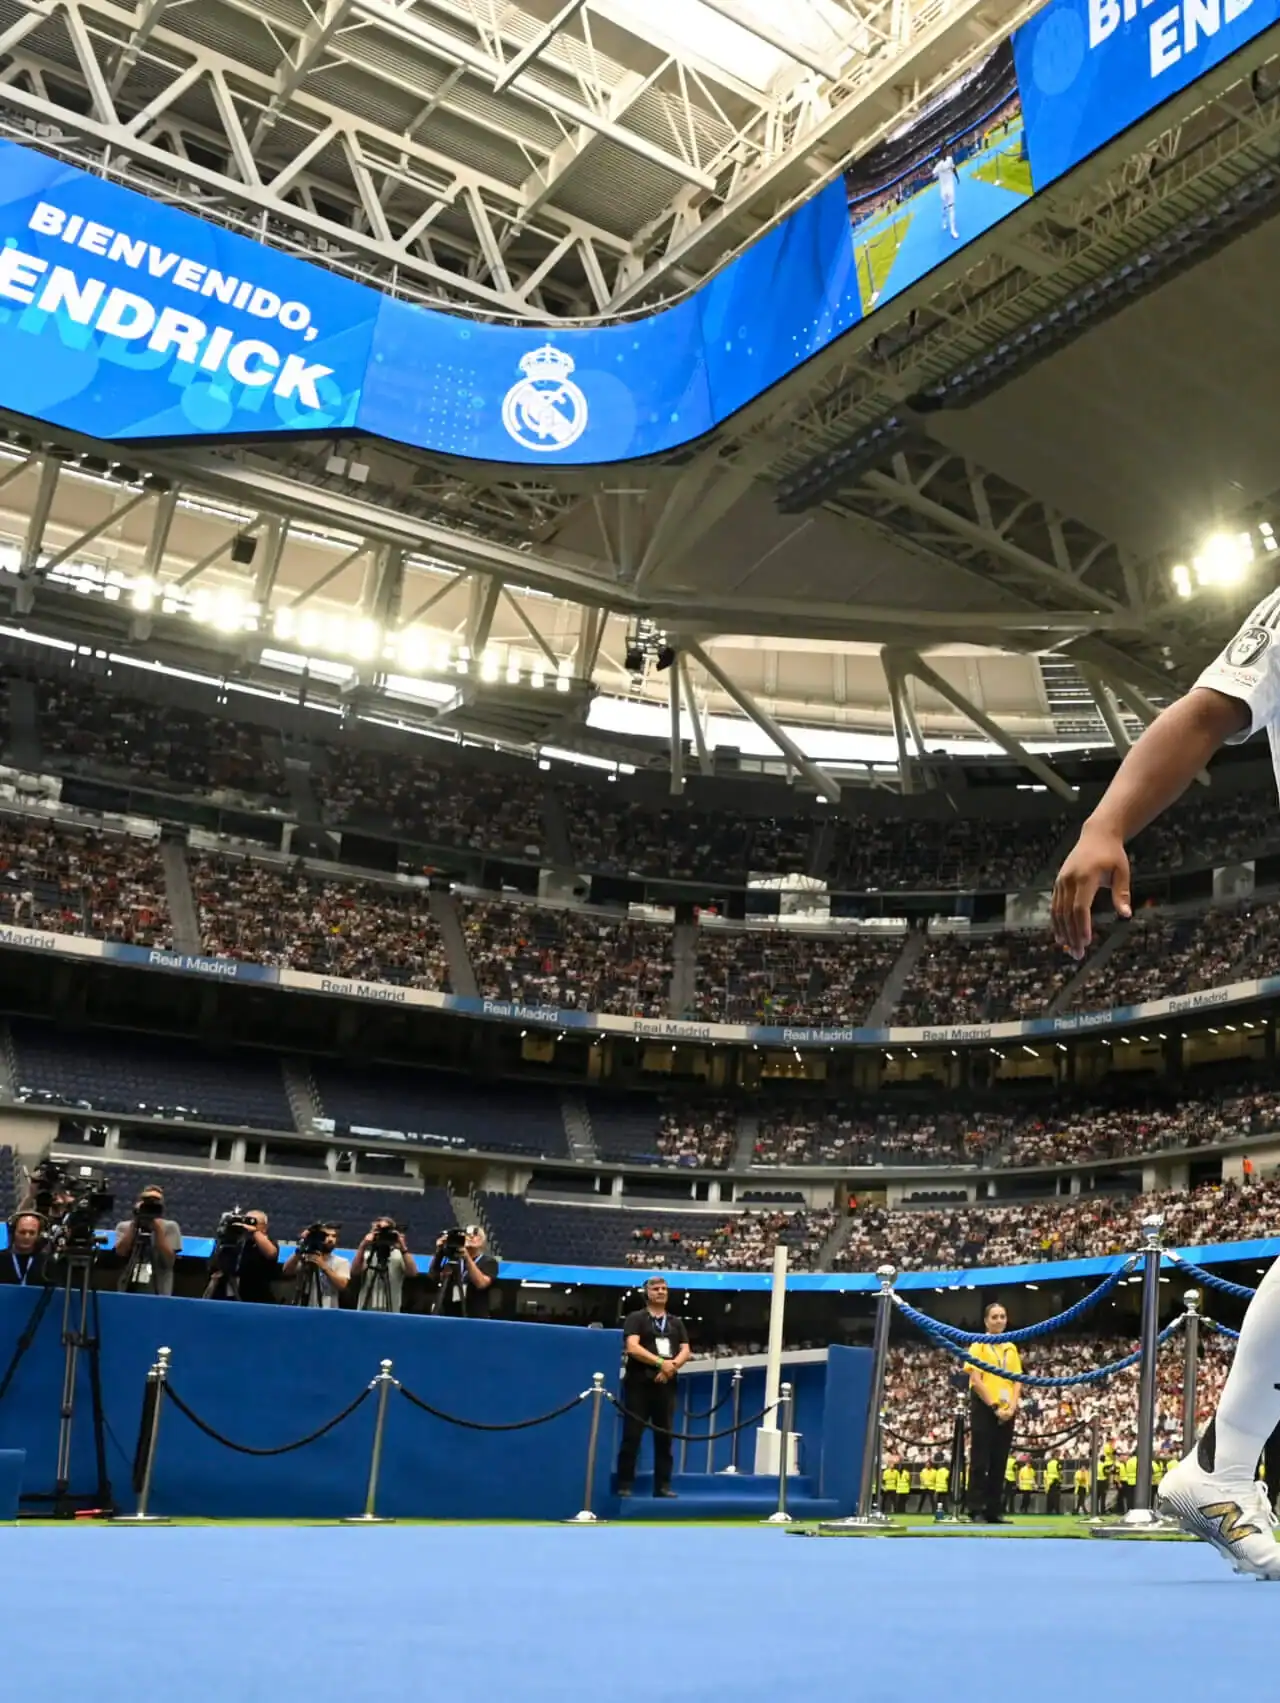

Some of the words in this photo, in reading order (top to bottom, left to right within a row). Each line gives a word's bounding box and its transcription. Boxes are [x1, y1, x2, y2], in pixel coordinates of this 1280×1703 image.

[28, 201, 319, 342] BIENVENIDO,
[0, 246, 335, 409] ENDRICK
[0, 929, 55, 949] Madrid
[150, 951, 182, 968] Real
[186, 957, 238, 976] Madrid
[321, 980, 353, 992] Real
[357, 985, 406, 1001] Madrid
[483, 1001, 511, 1016] Real
[514, 1006, 558, 1022] Madrid
[1169, 1000, 1192, 1013] Real
[1193, 990, 1229, 1007] Madrid
[634, 1021, 661, 1033] Real
[665, 1024, 710, 1038] Madrid
[1054, 1017, 1078, 1030] Real
[1080, 1011, 1113, 1027] Madrid
[783, 1028, 809, 1041] Real
[813, 1028, 853, 1041] Madrid
[922, 1029, 948, 1041] Real
[951, 1028, 991, 1041] Madrid
